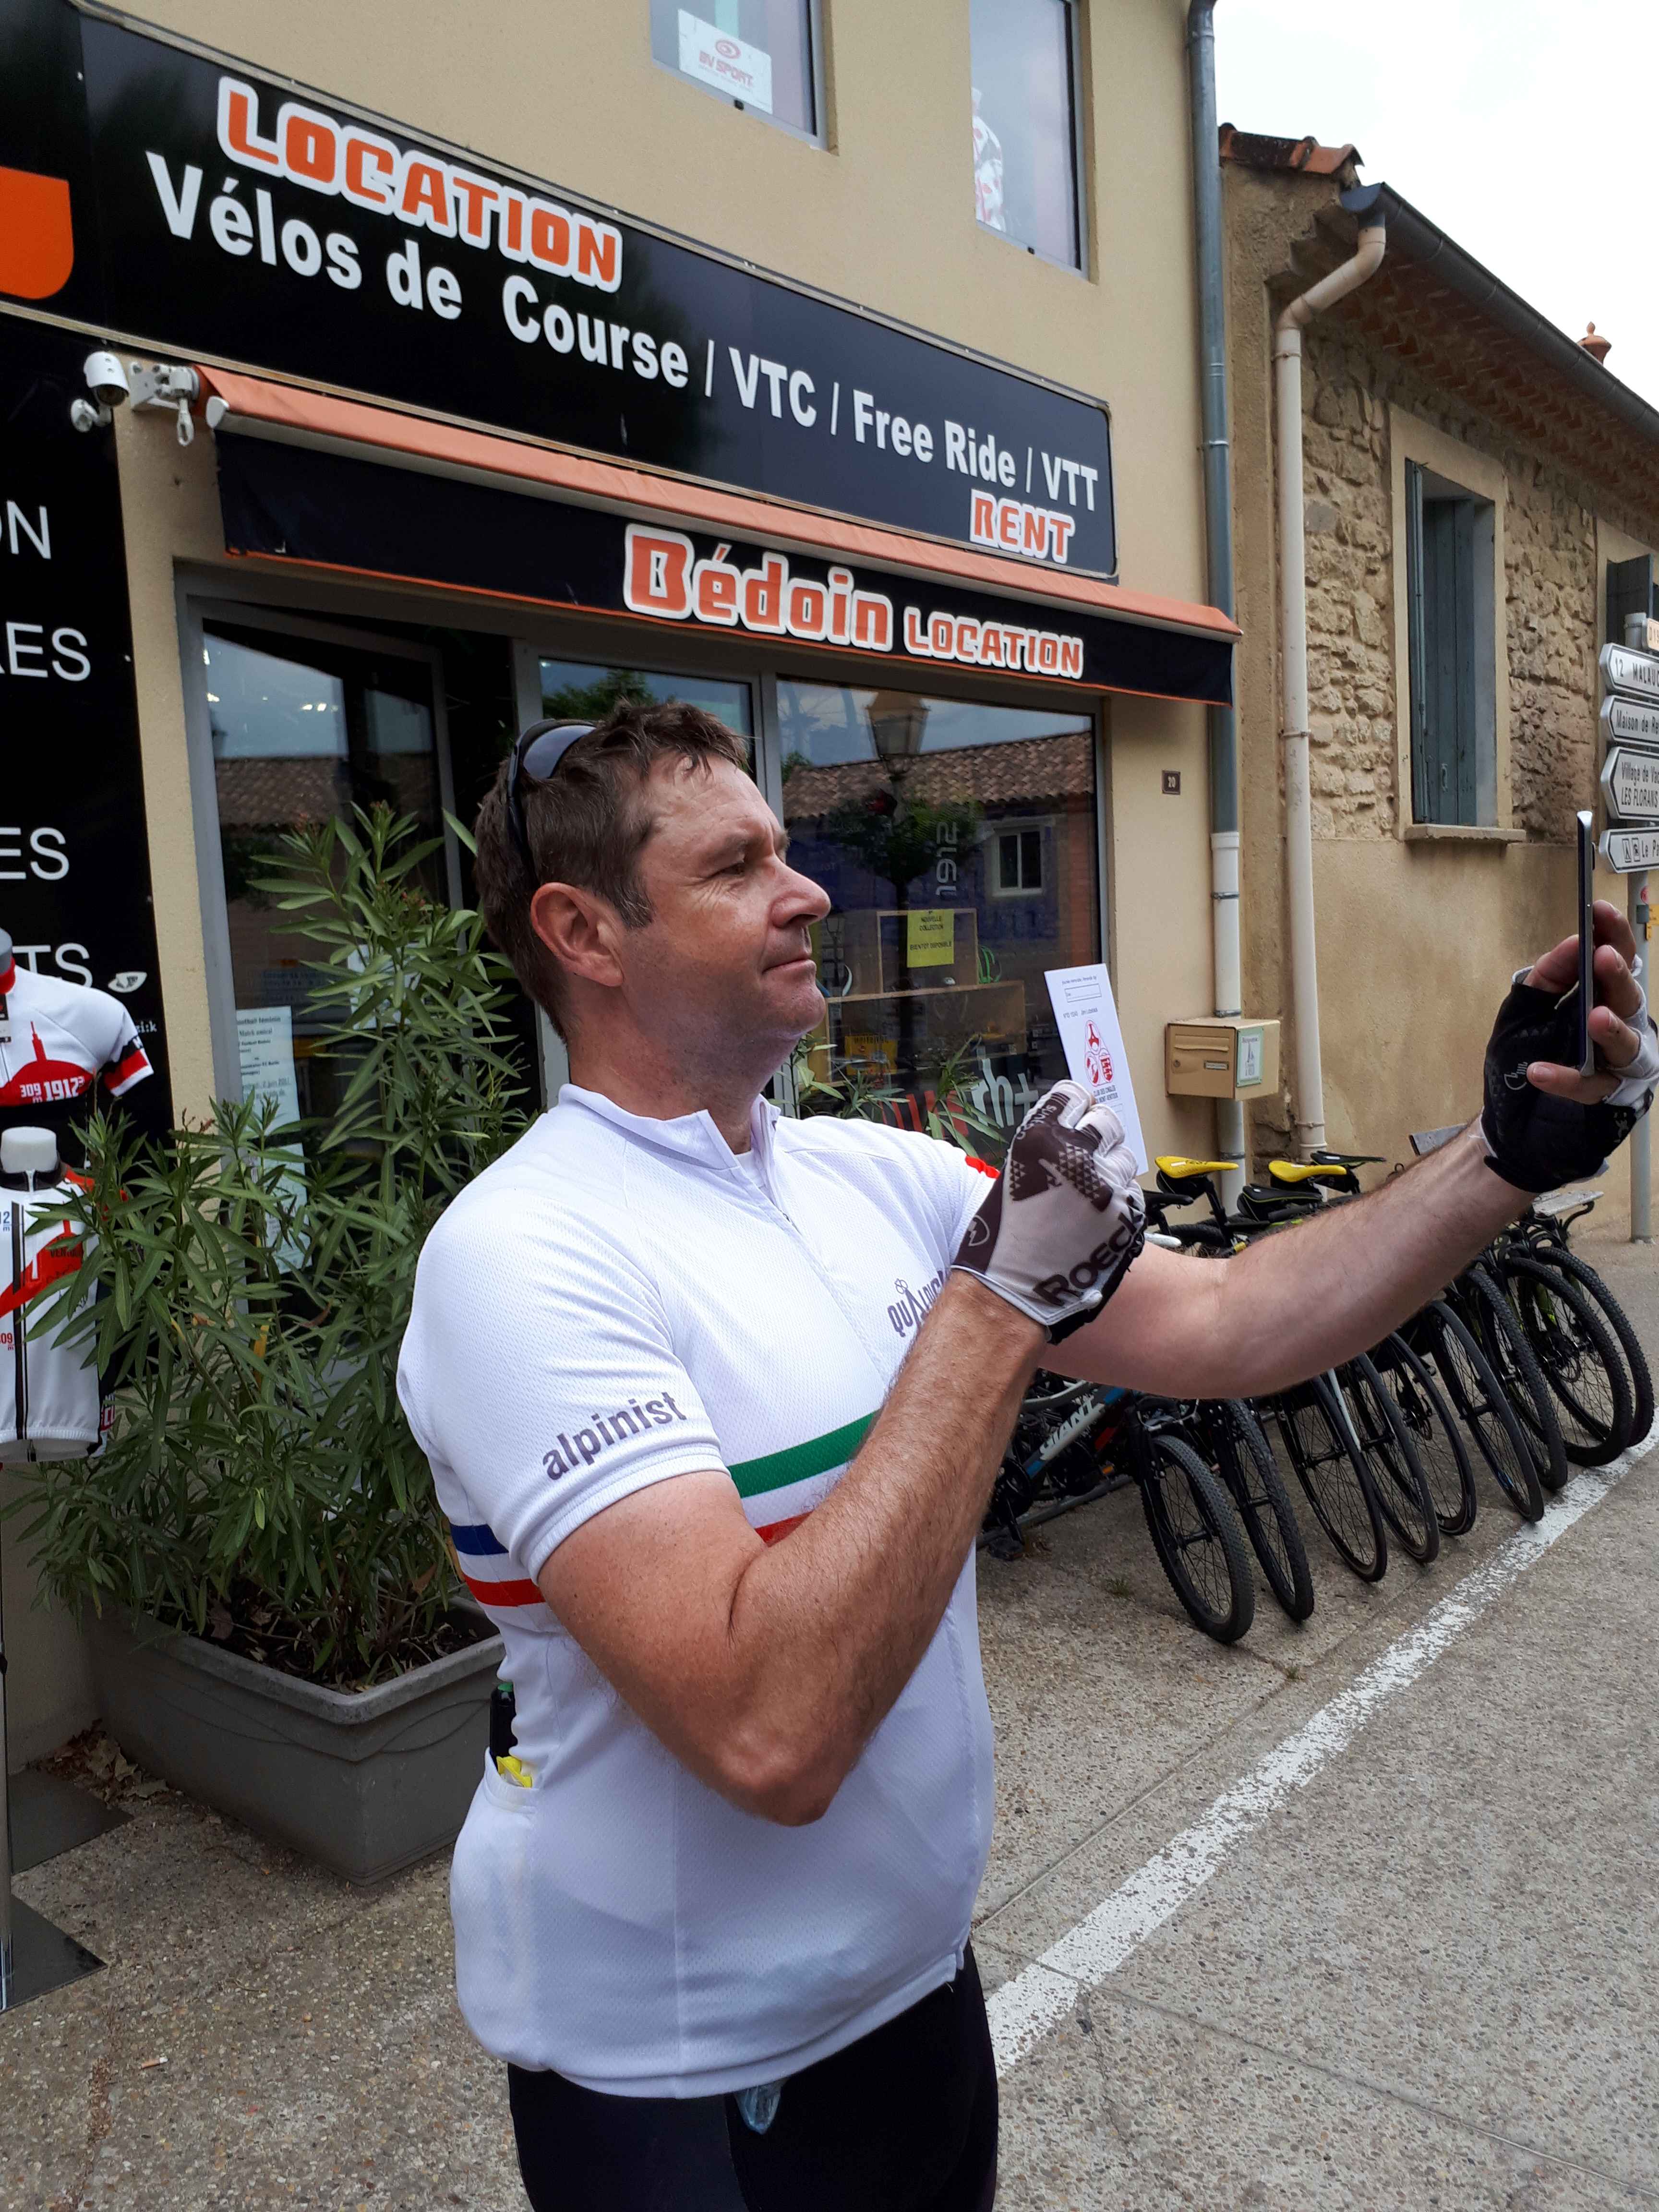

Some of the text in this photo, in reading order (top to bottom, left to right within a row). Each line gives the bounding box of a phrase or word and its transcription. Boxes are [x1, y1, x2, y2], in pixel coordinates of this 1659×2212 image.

[217, 76, 623, 293] LOCATION
[145, 151, 362, 289] Vélos
[386, 239, 462, 320] de
[503, 274, 689, 387] Course
[728, 347, 817, 427] VTC
[852, 389, 934, 462] Free
[944, 420, 1016, 488] Ride
[1041, 452, 1098, 511] VTT
[969, 488, 1075, 564] RENT
[623, 523, 1083, 680] Bédoin LOCATION
[1615, 657, 1624, 677] 12
[1616, 709, 1638, 731] Maison
[1642, 715, 1648, 733] de
[1622, 762, 1640, 786] Village
[1643, 765, 1648, 782] de
[1622, 787, 1658, 808] LES FLORANS
[1642, 840, 1648, 858] Le
[20, 1083, 42, 1098] 309
[44, 1077, 79, 1102] 1912
[543, 1392, 687, 1480] alpinist
